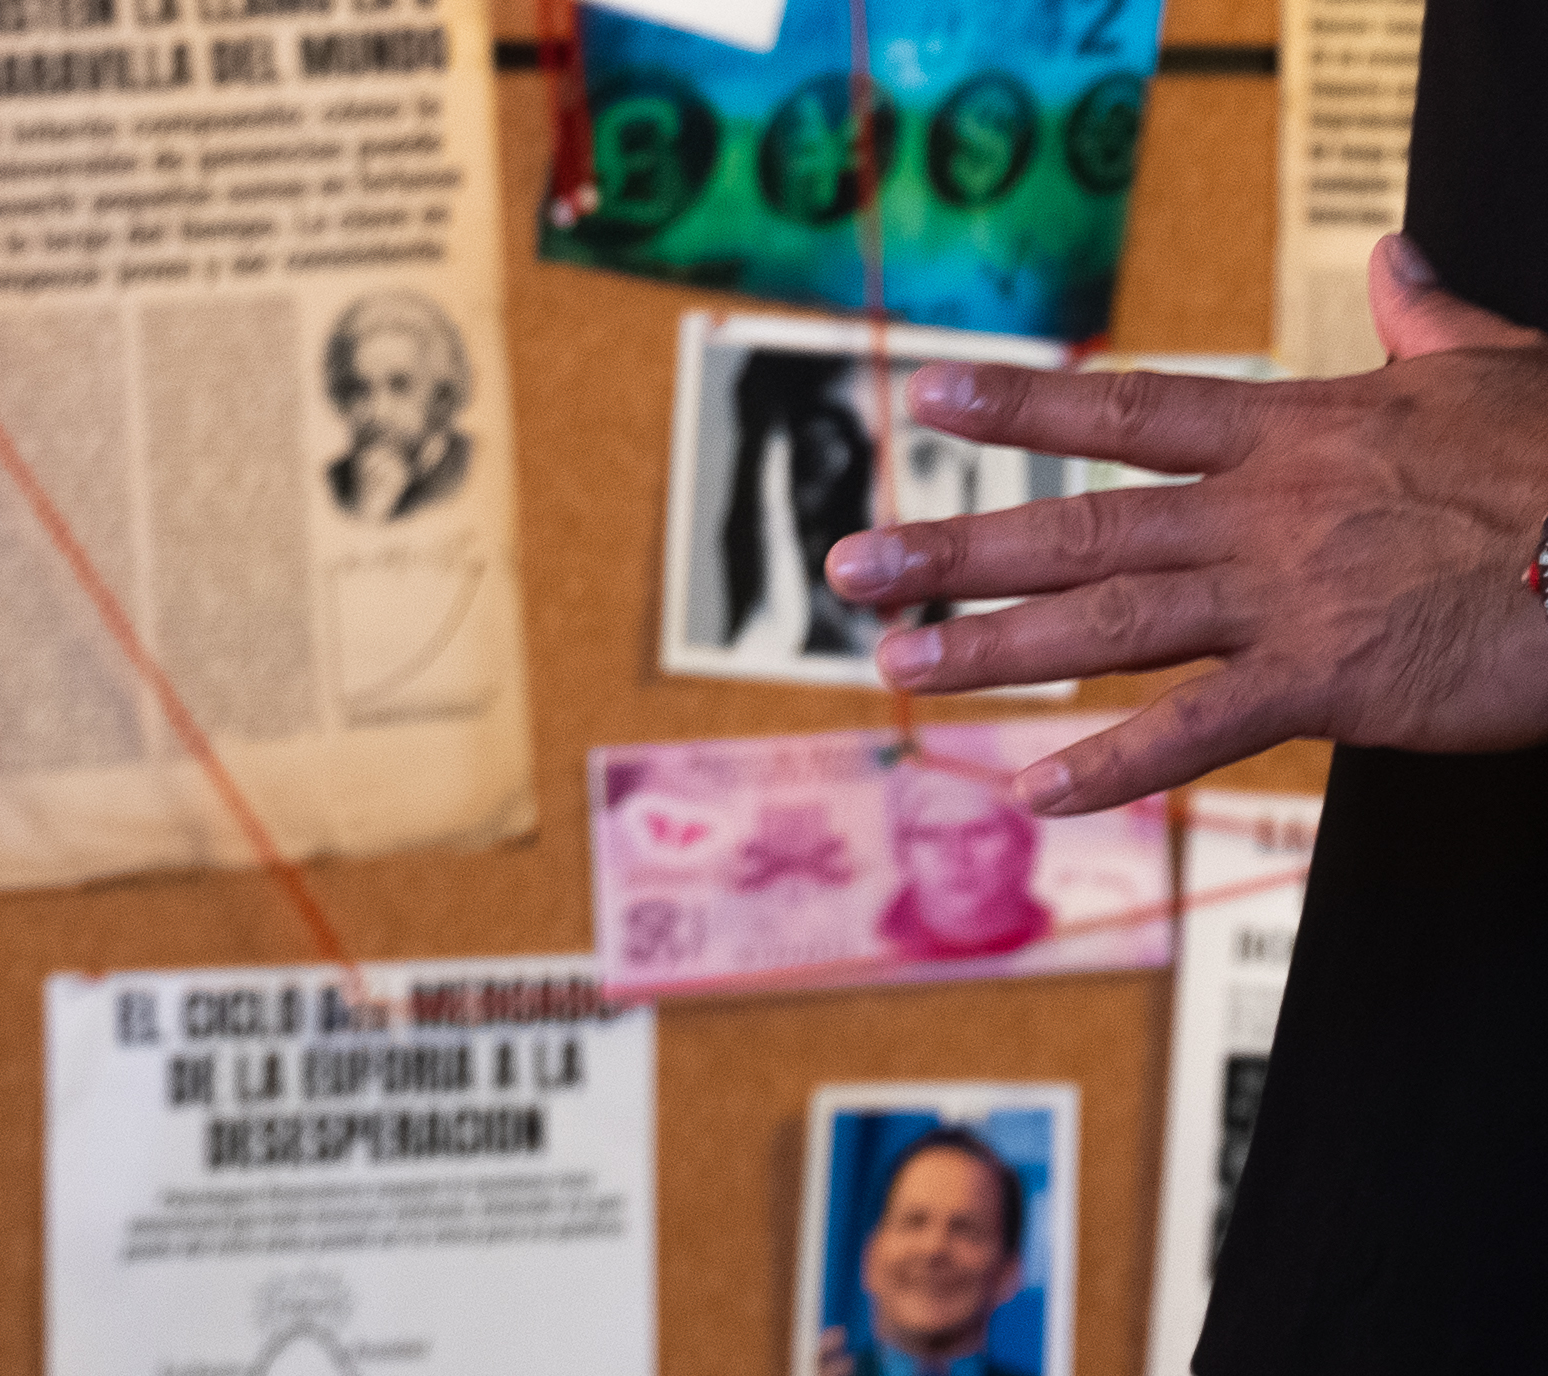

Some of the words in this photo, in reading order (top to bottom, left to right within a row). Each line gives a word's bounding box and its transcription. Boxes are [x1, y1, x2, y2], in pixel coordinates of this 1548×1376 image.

[208, 37, 279, 86] DEL
[299, 25, 450, 77] MUNDO
[237, 1053, 282, 1103] LA
[491, 1037, 517, 1090] A
[532, 1037, 586, 1092] LA
